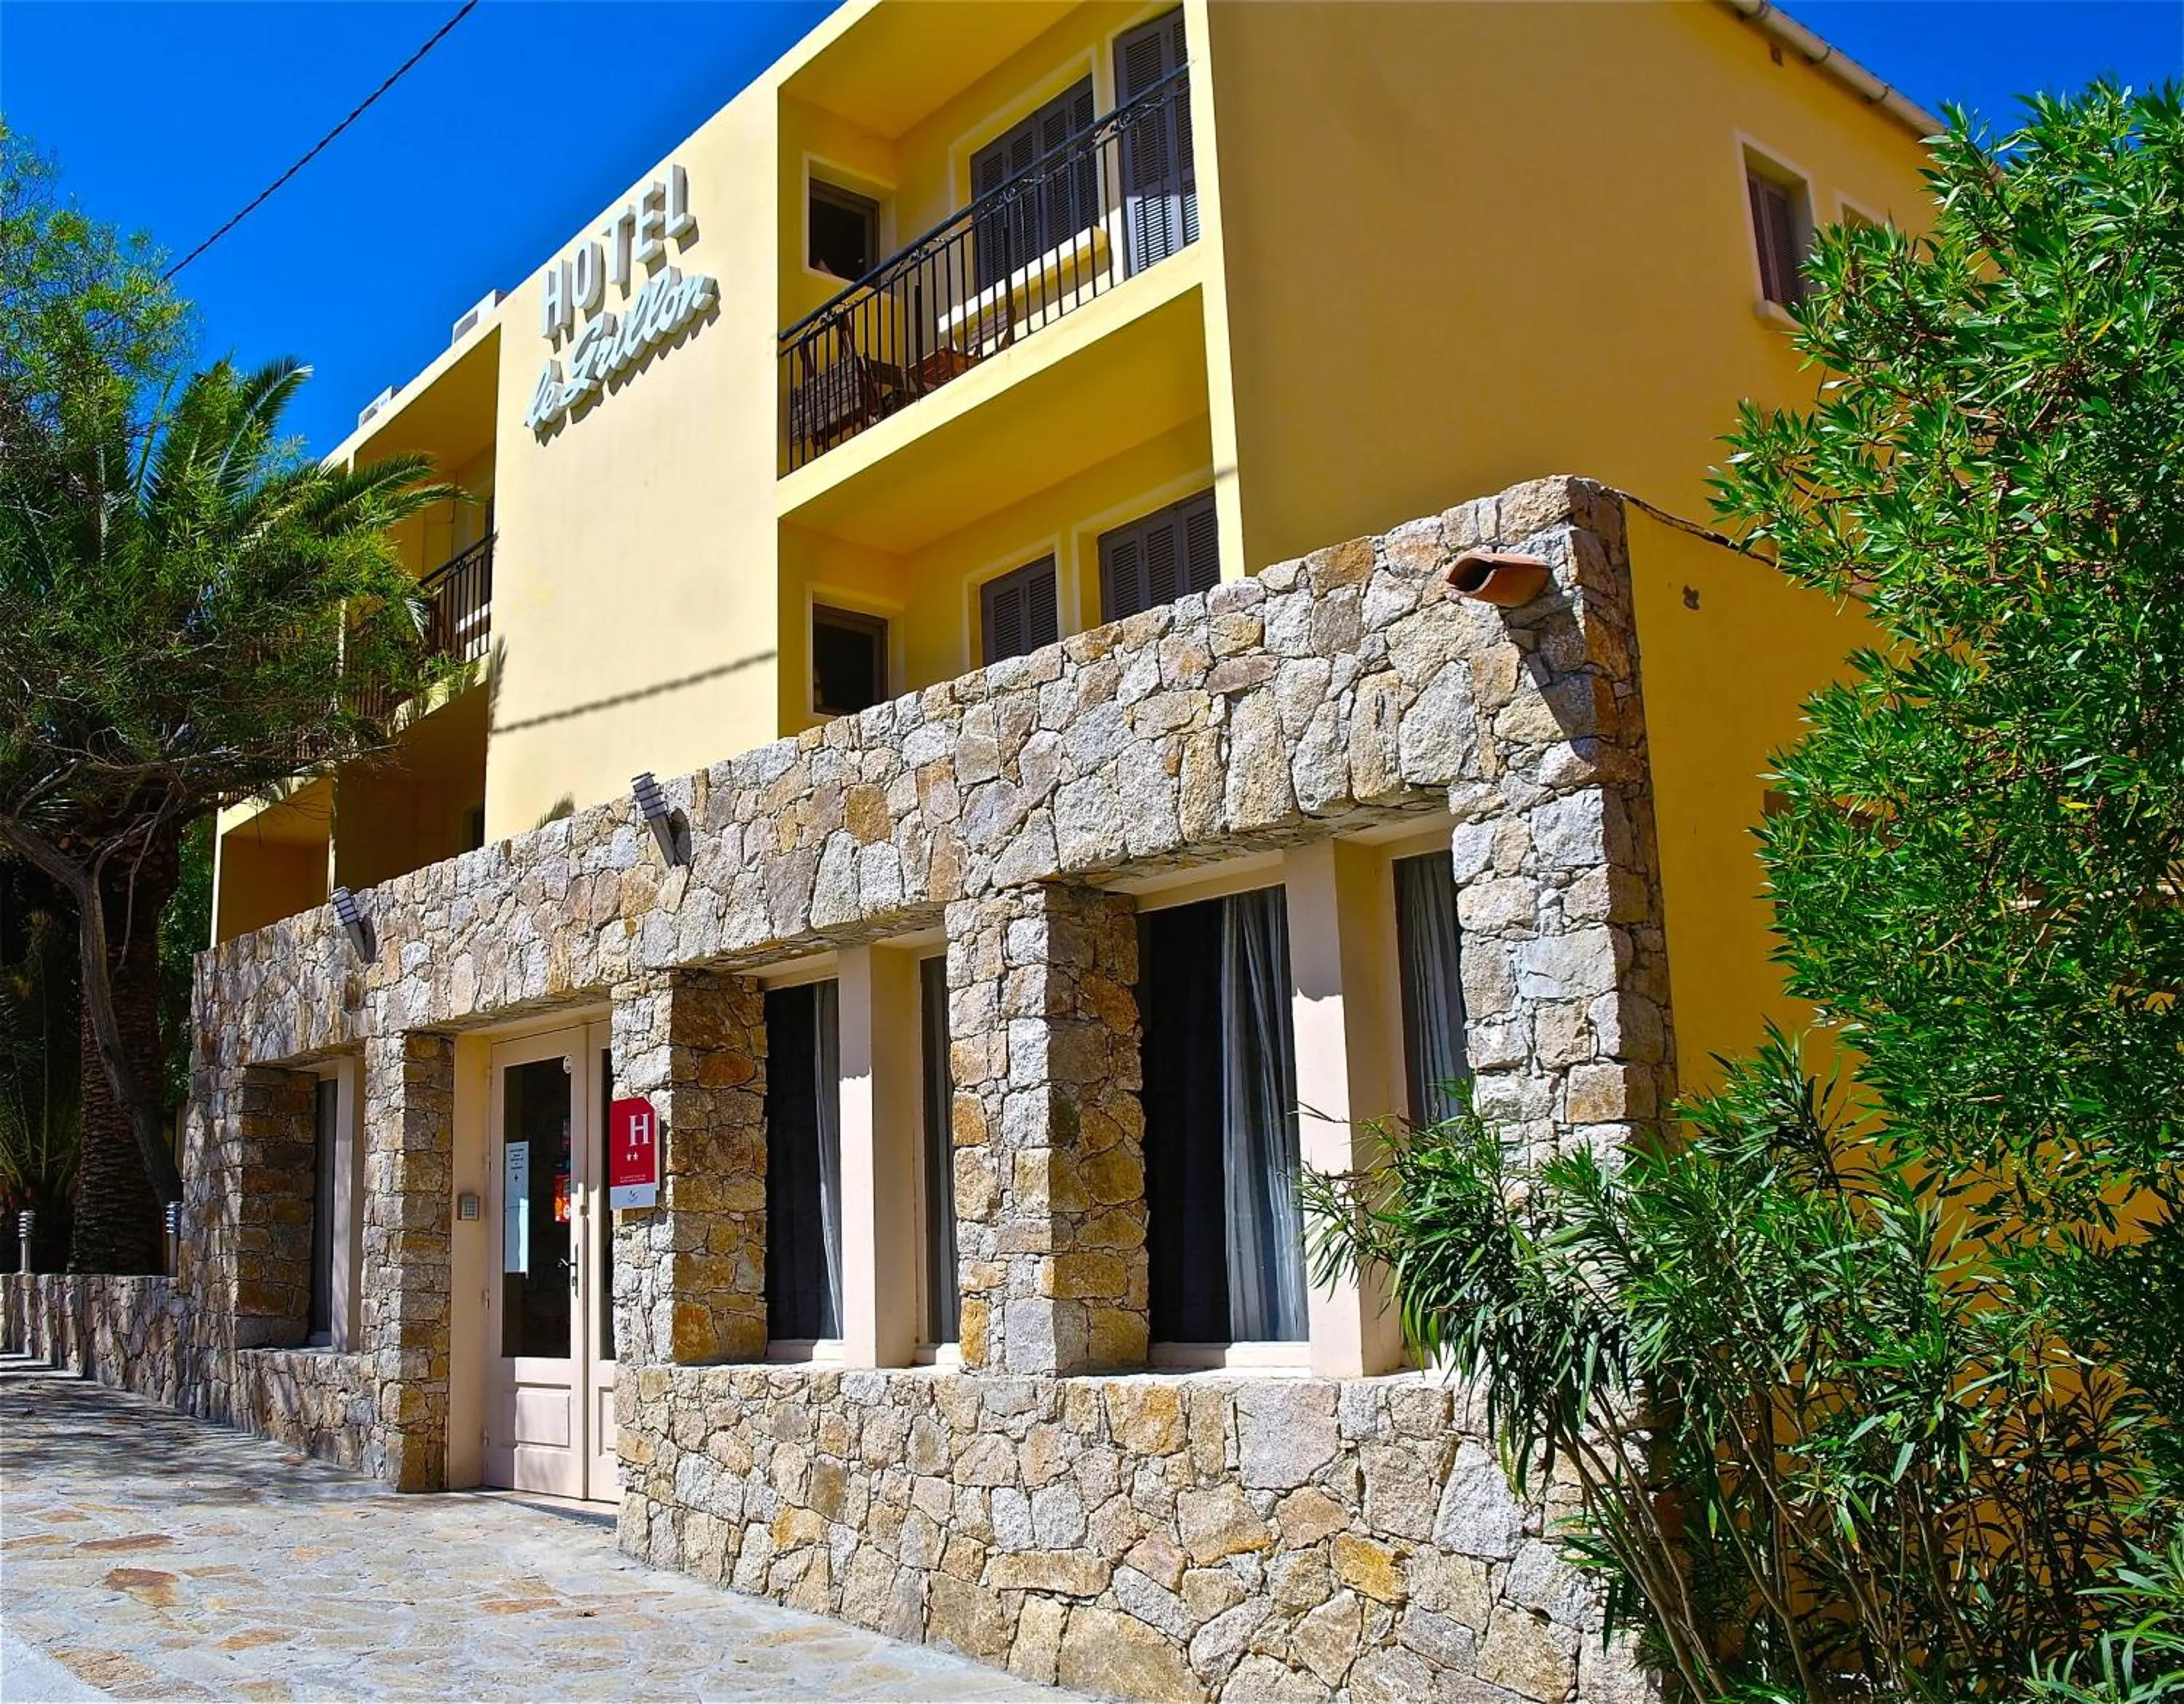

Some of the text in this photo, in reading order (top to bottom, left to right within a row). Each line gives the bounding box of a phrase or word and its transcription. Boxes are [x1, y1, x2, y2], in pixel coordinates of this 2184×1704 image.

[542, 164, 696, 339] HOTEL
[558, 266, 718, 409] Grillon
[629, 1113, 651, 1147] H
